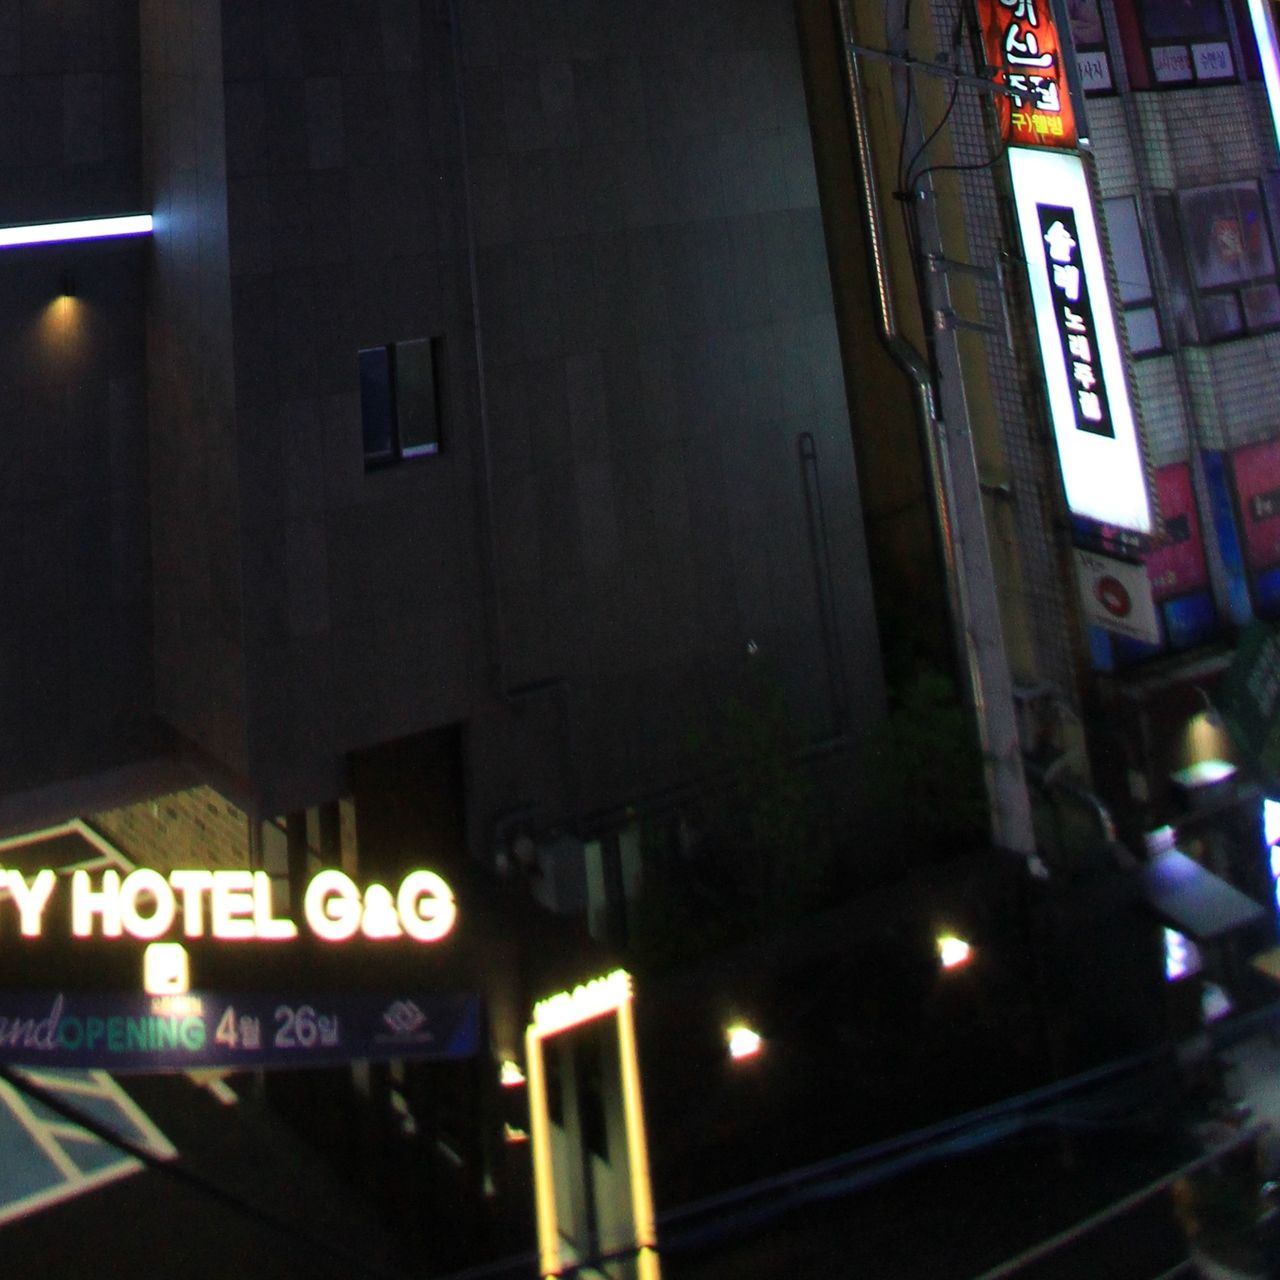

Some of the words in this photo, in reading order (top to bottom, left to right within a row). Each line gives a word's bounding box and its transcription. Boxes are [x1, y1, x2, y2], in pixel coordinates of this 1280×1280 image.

[71, 868, 298, 939] HOTEL
[304, 868, 457, 942] G&G
[57, 1012, 208, 1052] OPENING
